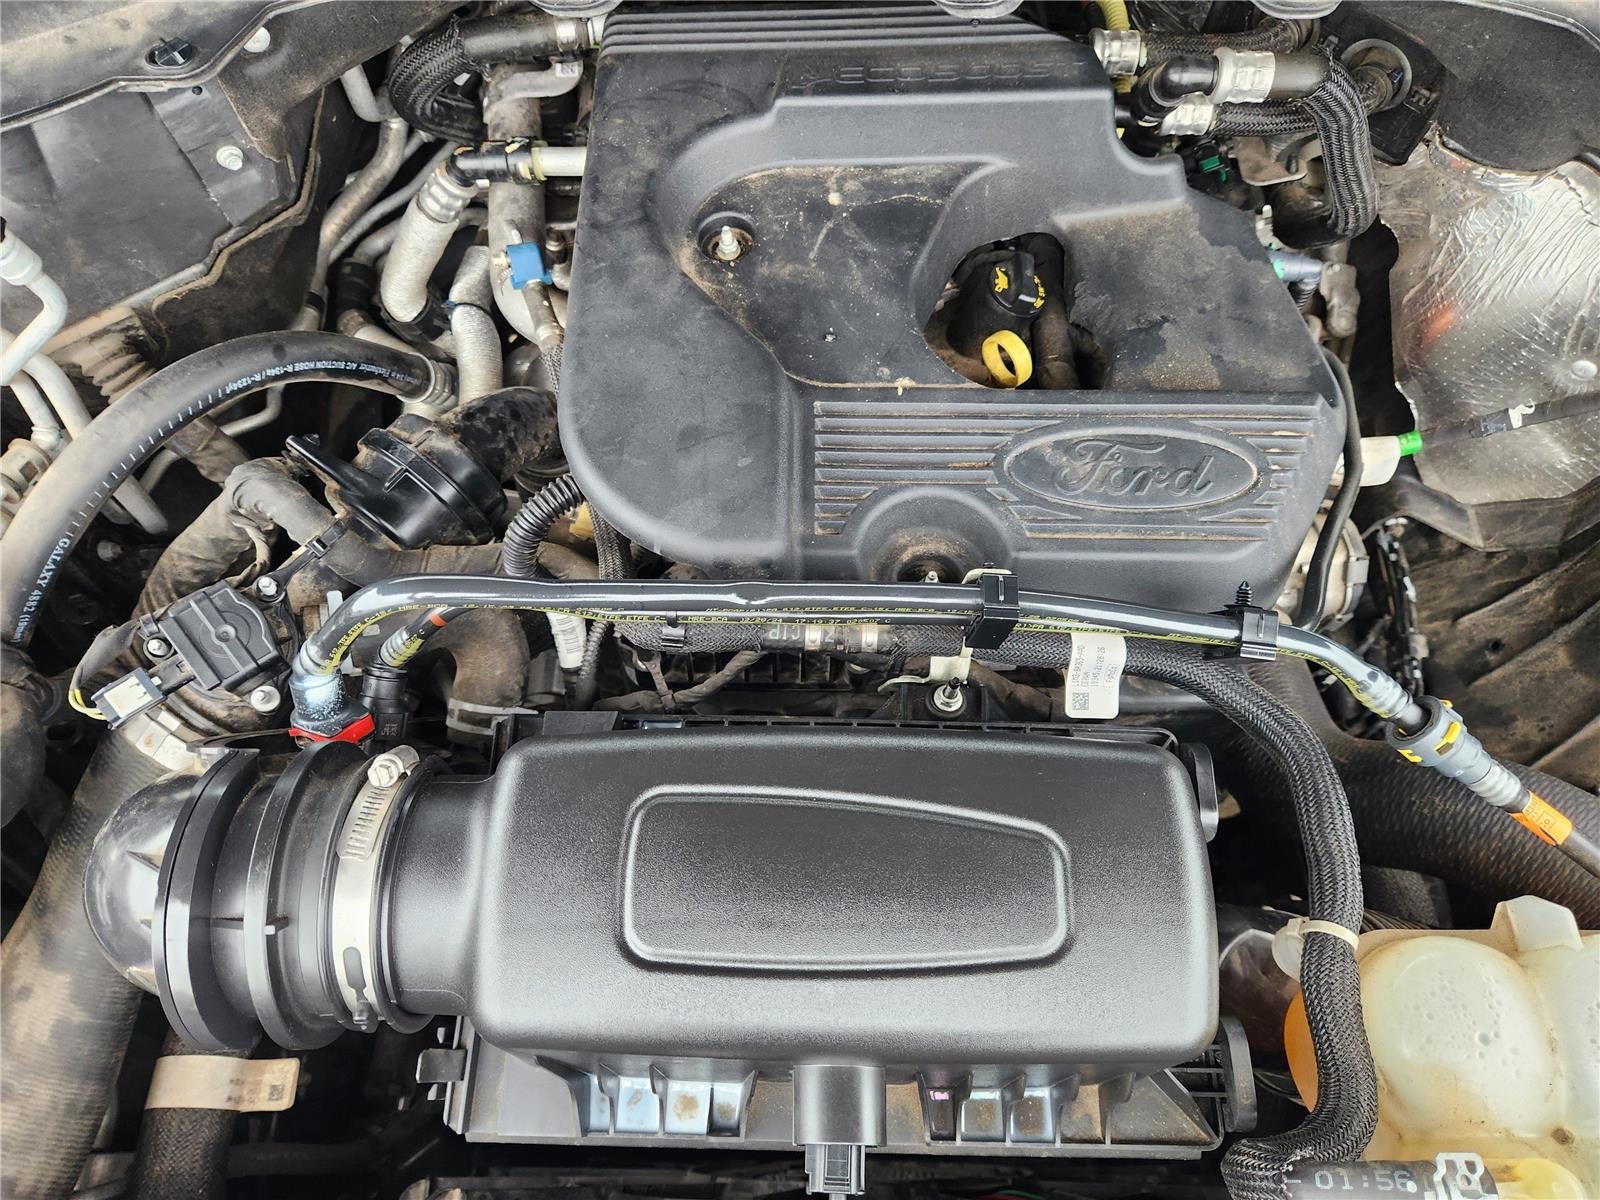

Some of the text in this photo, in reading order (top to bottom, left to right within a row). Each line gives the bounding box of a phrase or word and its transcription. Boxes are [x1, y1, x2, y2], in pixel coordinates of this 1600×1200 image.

[293, 360, 315, 372] HOSE
[315, 360, 346, 369] SUCTION
[1053, 437, 1214, 496] Ford
[36, 538, 70, 587] GALAXY
